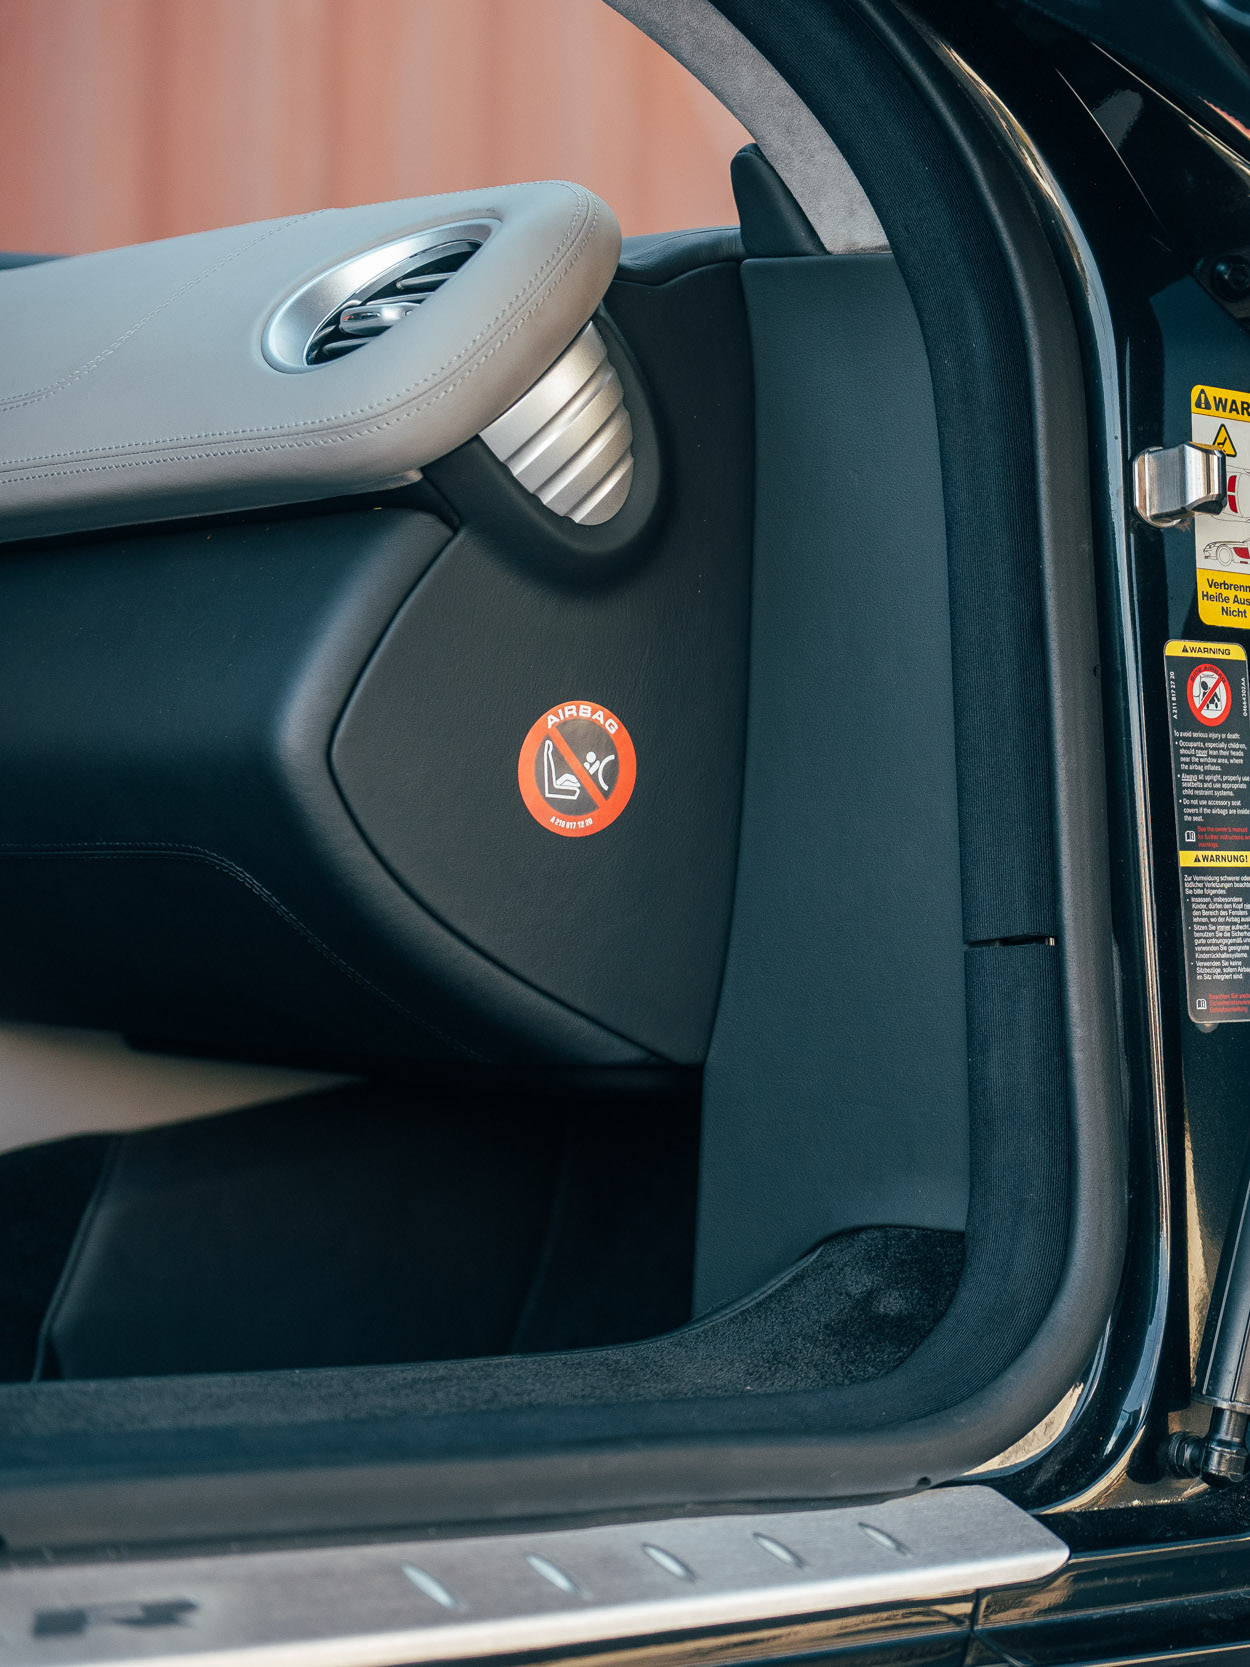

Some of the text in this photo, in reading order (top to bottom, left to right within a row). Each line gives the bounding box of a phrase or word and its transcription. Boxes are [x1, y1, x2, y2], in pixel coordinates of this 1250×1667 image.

[1202, 591, 1229, 604] Heiße
[1221, 606, 1247, 618] Nicht
[1189, 646, 1230, 655] WARNING
[547, 705, 619, 735] AIRBAG
[1179, 740, 1204, 748] Occupants,
[1228, 742, 1247, 750] children,
[1182, 773, 1197, 781] Always
[1212, 808, 1228, 816] airbags
[555, 819, 566, 828] 210
[578, 821, 585, 829] 12
[585, 818, 593, 827] 20
[1202, 855, 1248, 863] WARNUNG!
[1193, 875, 1219, 883] Vermeidung
[1204, 888, 1227, 896] folgendes:
